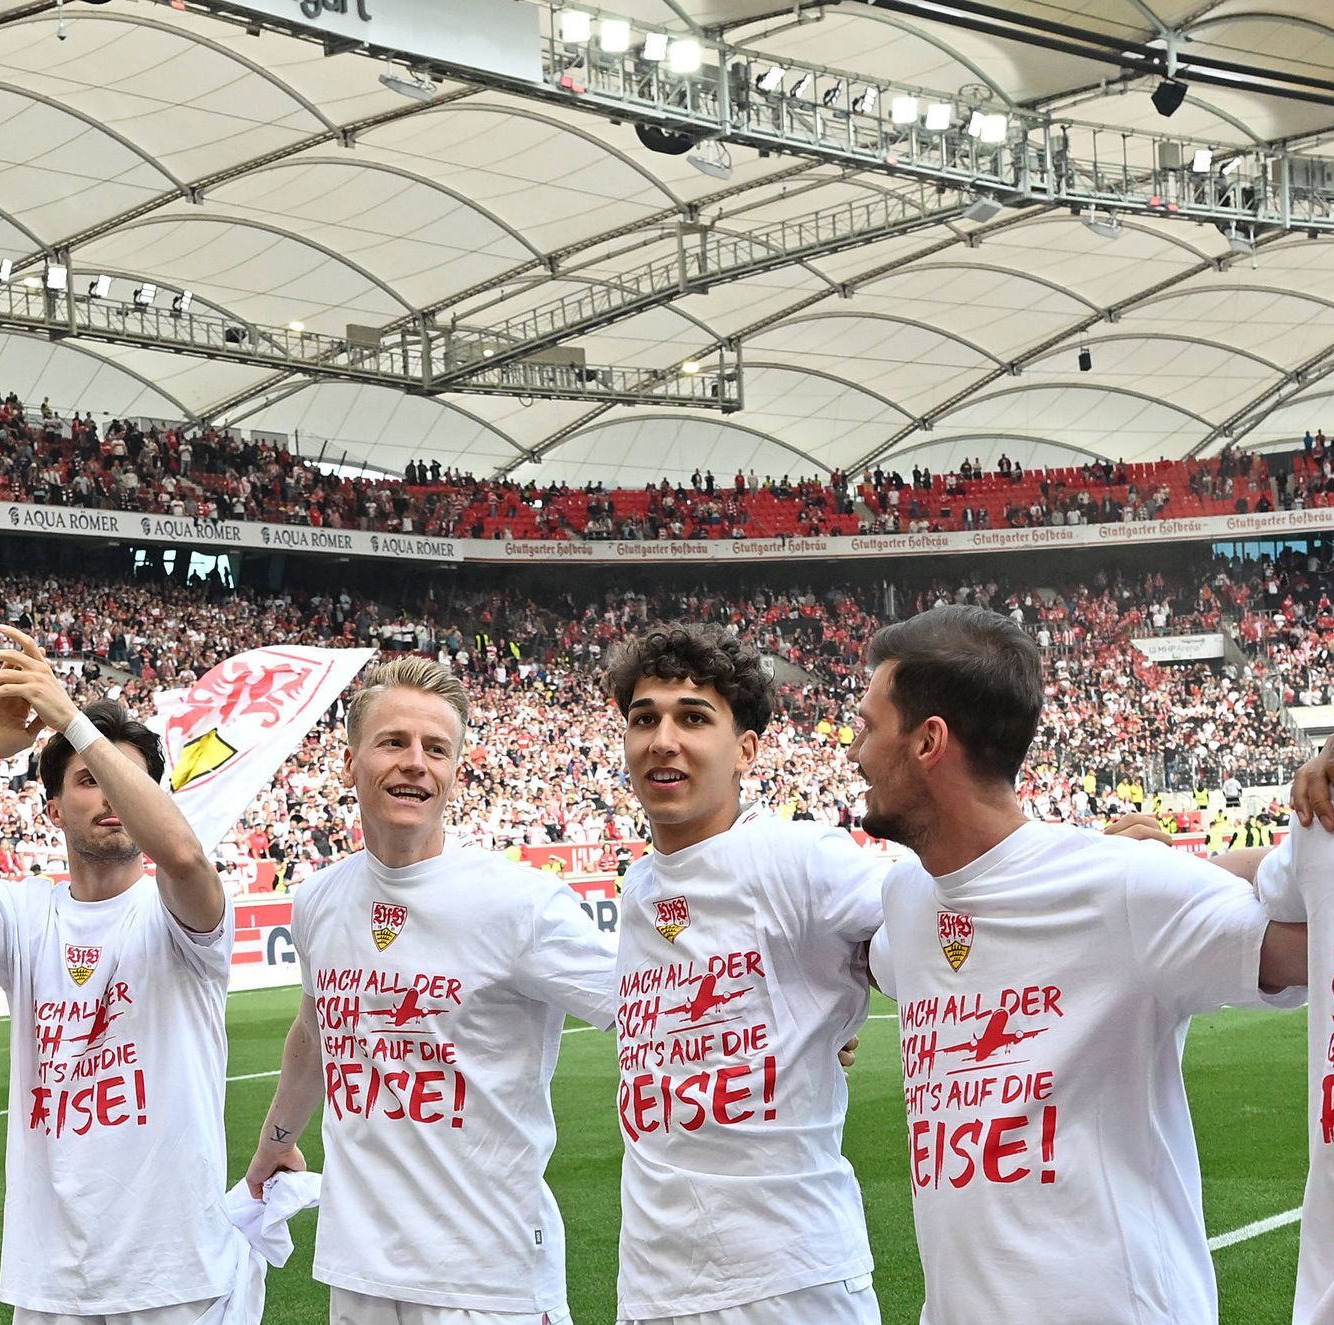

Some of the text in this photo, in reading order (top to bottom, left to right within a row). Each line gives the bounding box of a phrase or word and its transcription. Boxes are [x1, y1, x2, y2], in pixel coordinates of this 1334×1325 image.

[23, 510, 118, 532] AQUA RÖMER
[154, 521, 192, 539] AQUA
[273, 530, 308, 547] AQUA
[381, 538, 415, 554] AQUA
[317, 969, 462, 1005] NACH ALL DER
[620, 952, 765, 998] NACH ALL DER
[108, 982, 132, 1005] ER
[943, 994, 993, 1025] ALL
[1000, 986, 1063, 1018] DER
[101, 1043, 137, 1070] DIE
[325, 1035, 456, 1064] EHT'S AUF DIE
[670, 1035, 714, 1064] AUF
[722, 1024, 768, 1056] DIE
[325, 1062, 466, 1128] REISE!
[620, 1056, 776, 1143] REISE!
[905, 1072, 1053, 1115] HT'S AUF DIE
[910, 1106, 1057, 1196] EISE!
